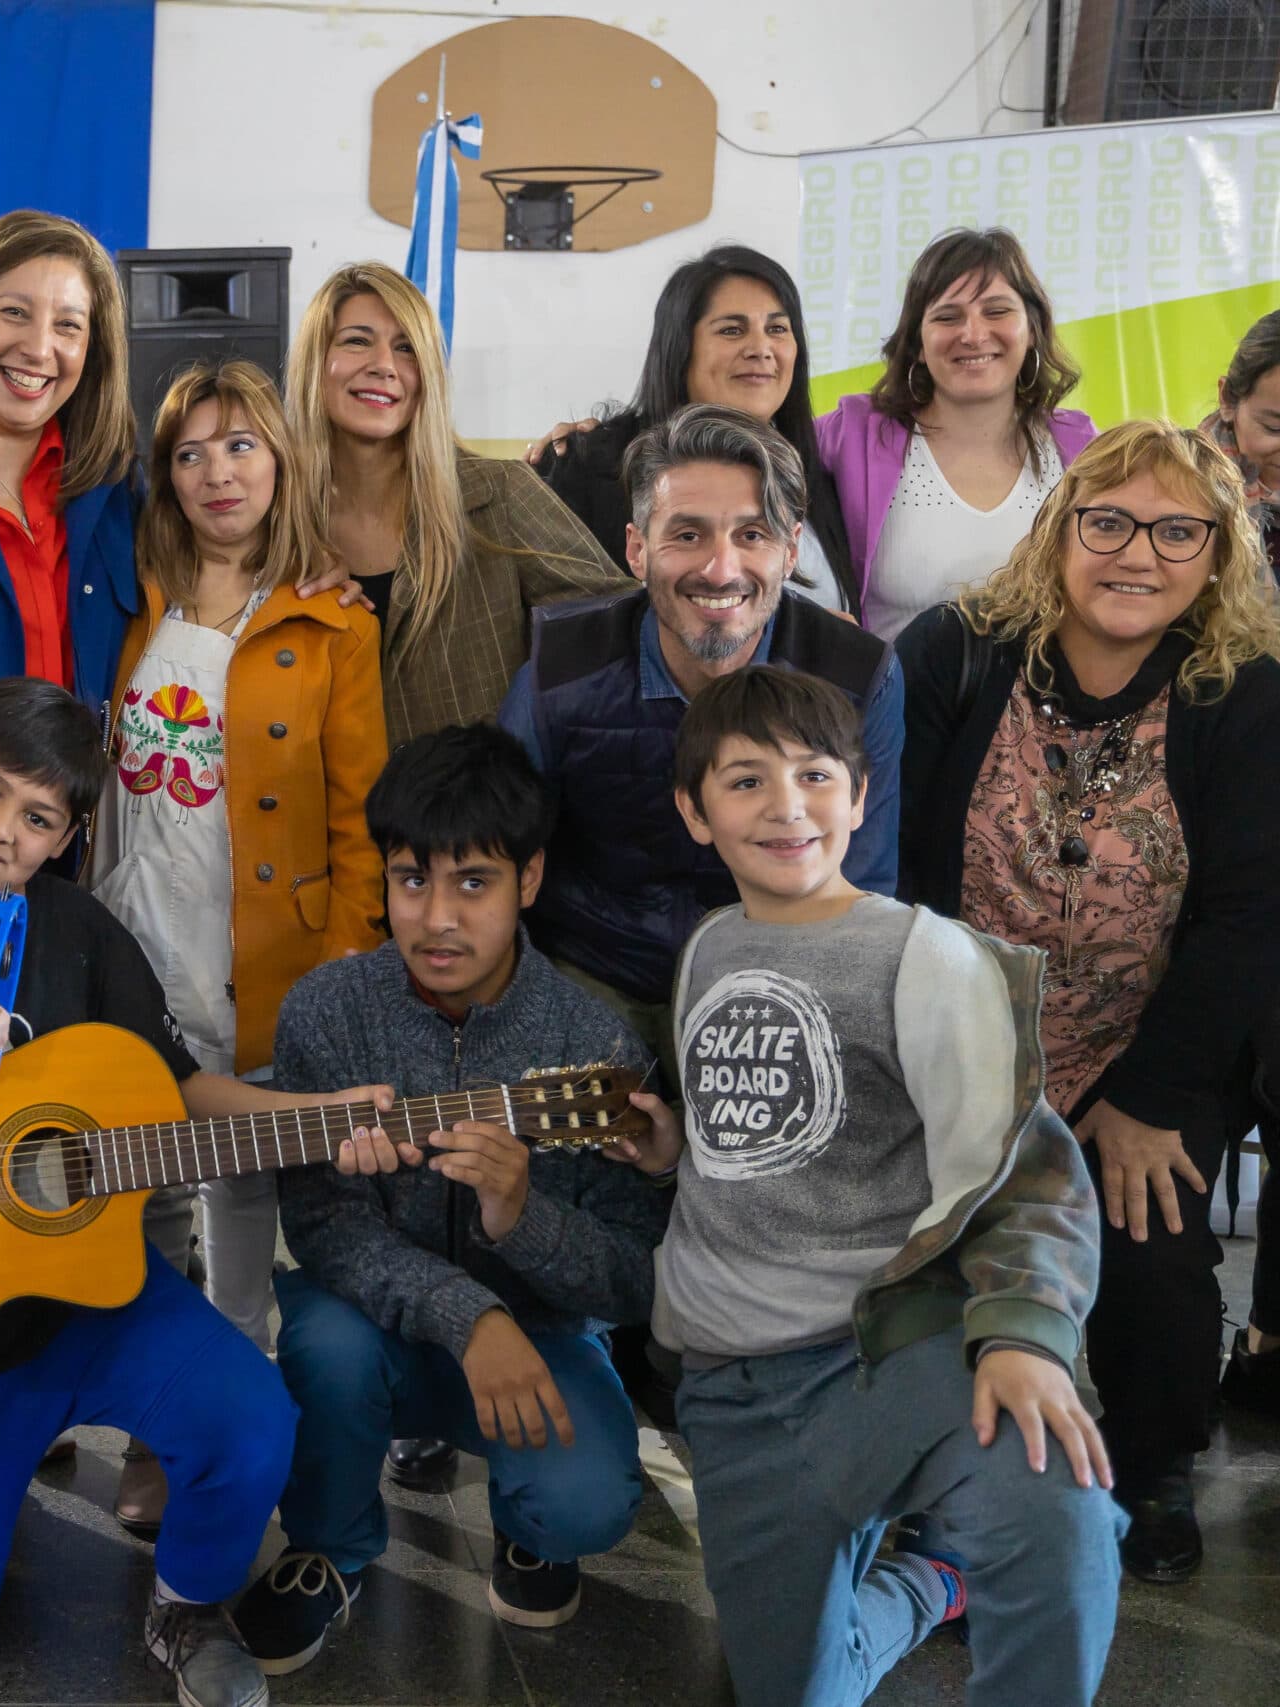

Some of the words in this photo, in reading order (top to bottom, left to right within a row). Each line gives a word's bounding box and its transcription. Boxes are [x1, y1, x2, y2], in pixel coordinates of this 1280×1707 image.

[695, 1025, 800, 1061] SKATE
[697, 1065, 791, 1096] BOARD
[708, 1099, 772, 1130] ING
[716, 1131, 751, 1147] 1997
